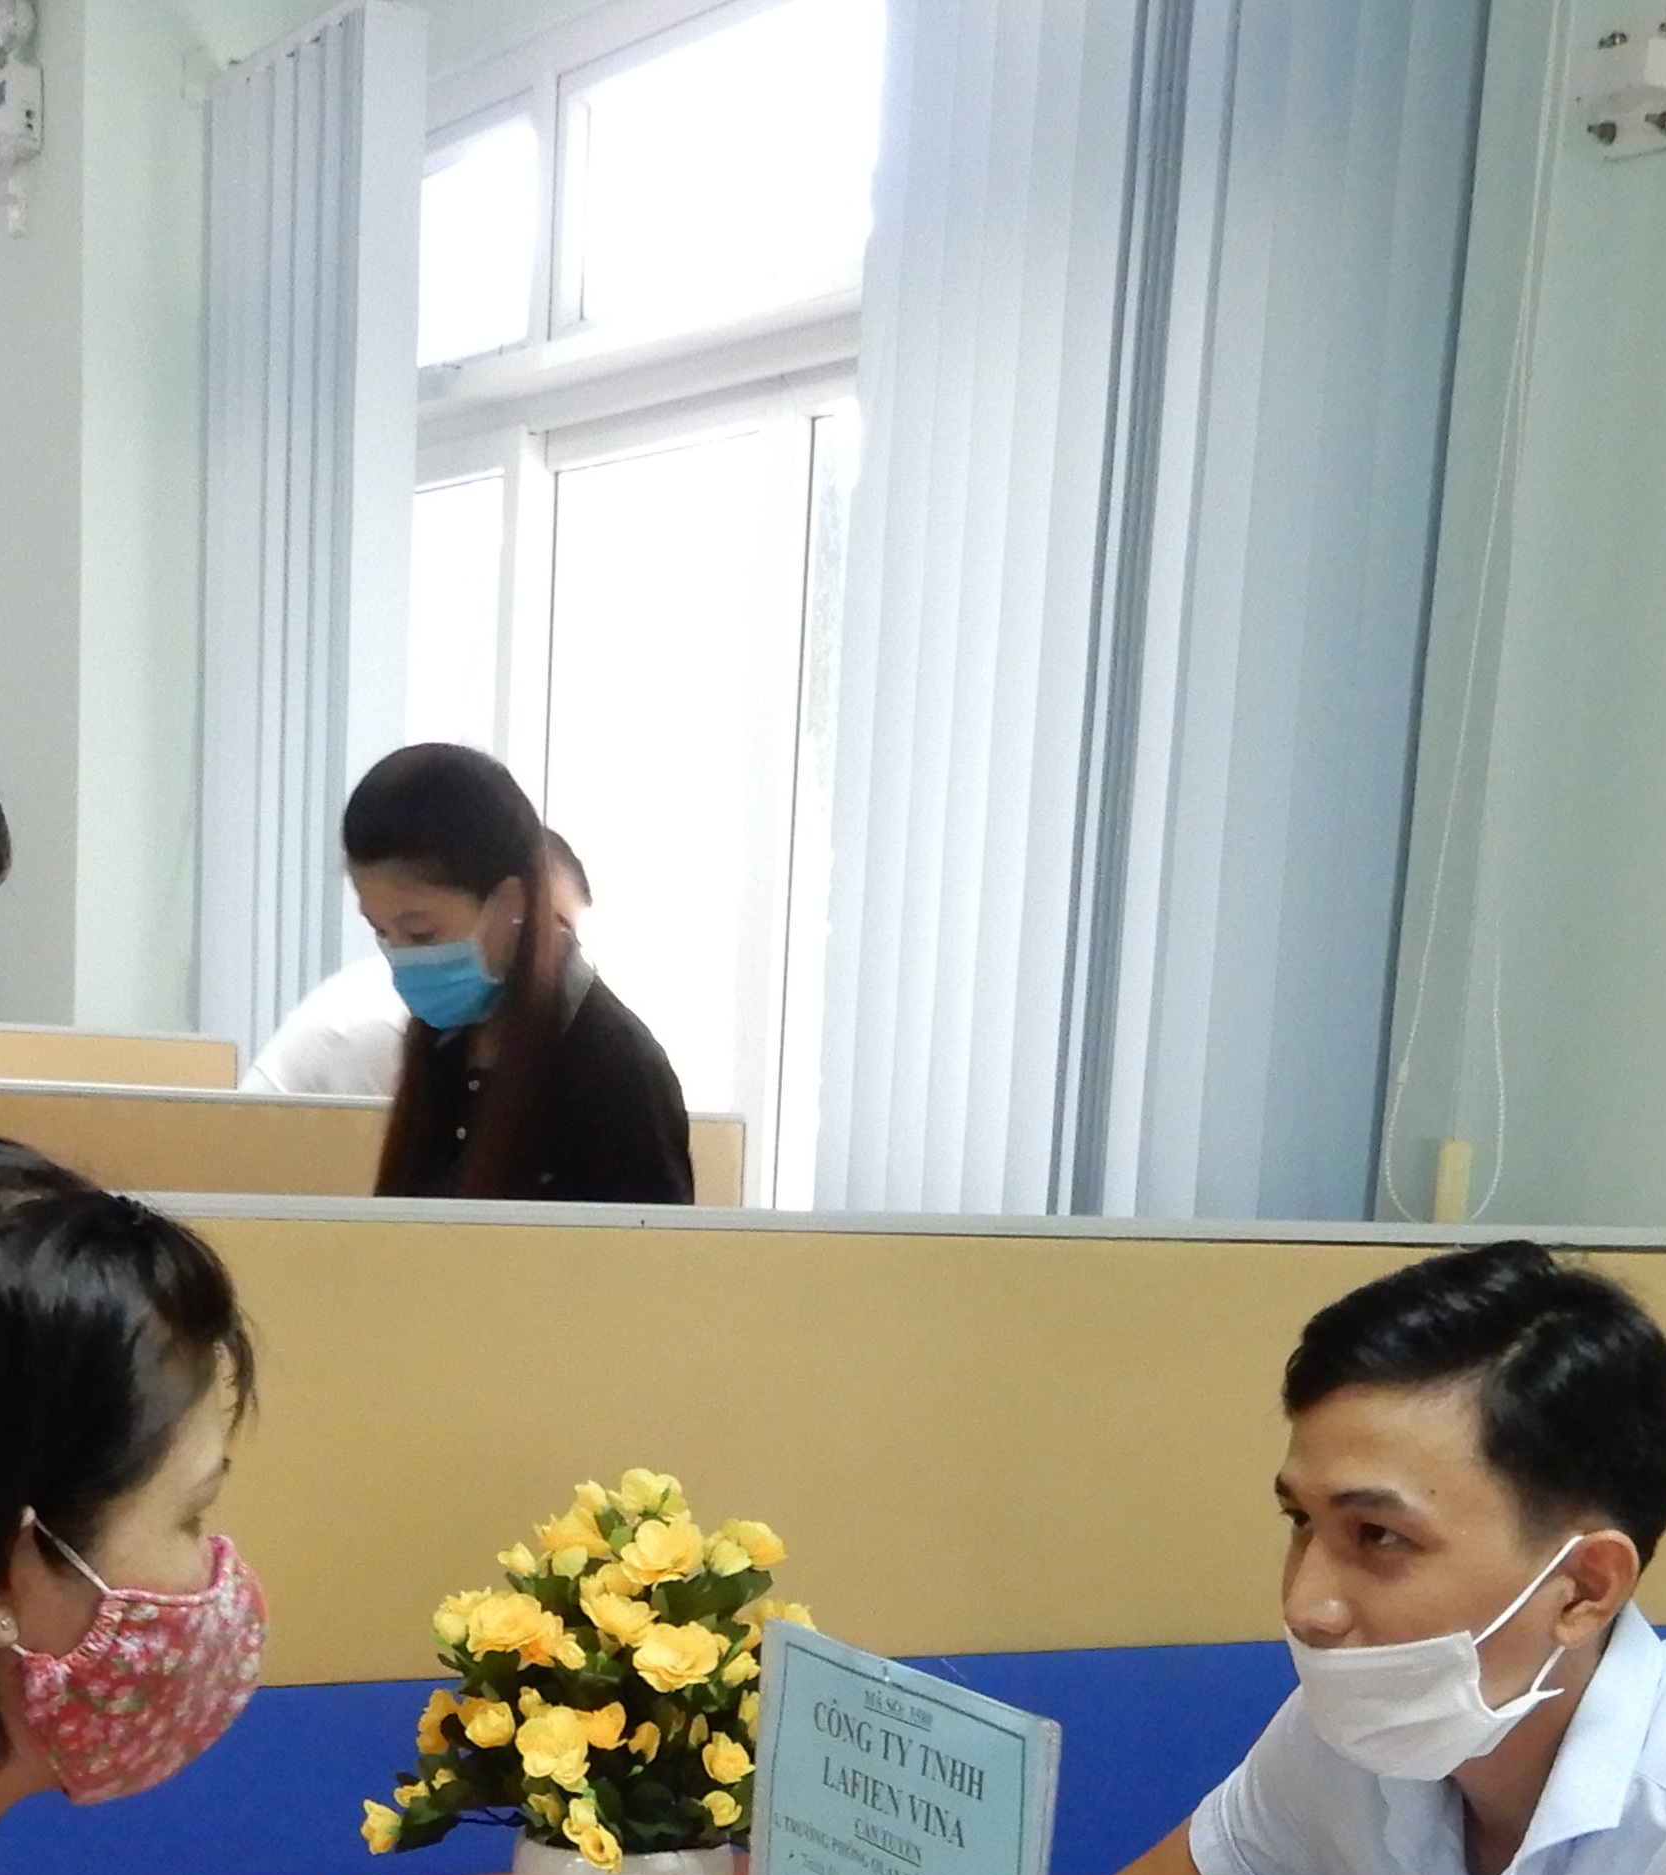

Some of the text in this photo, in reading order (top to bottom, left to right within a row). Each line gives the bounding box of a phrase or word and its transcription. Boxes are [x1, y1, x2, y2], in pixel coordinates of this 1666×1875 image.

[813, 1698, 985, 1800] CÔNG TY TNHH
[823, 1755, 965, 1849] LAFIEN VINA
